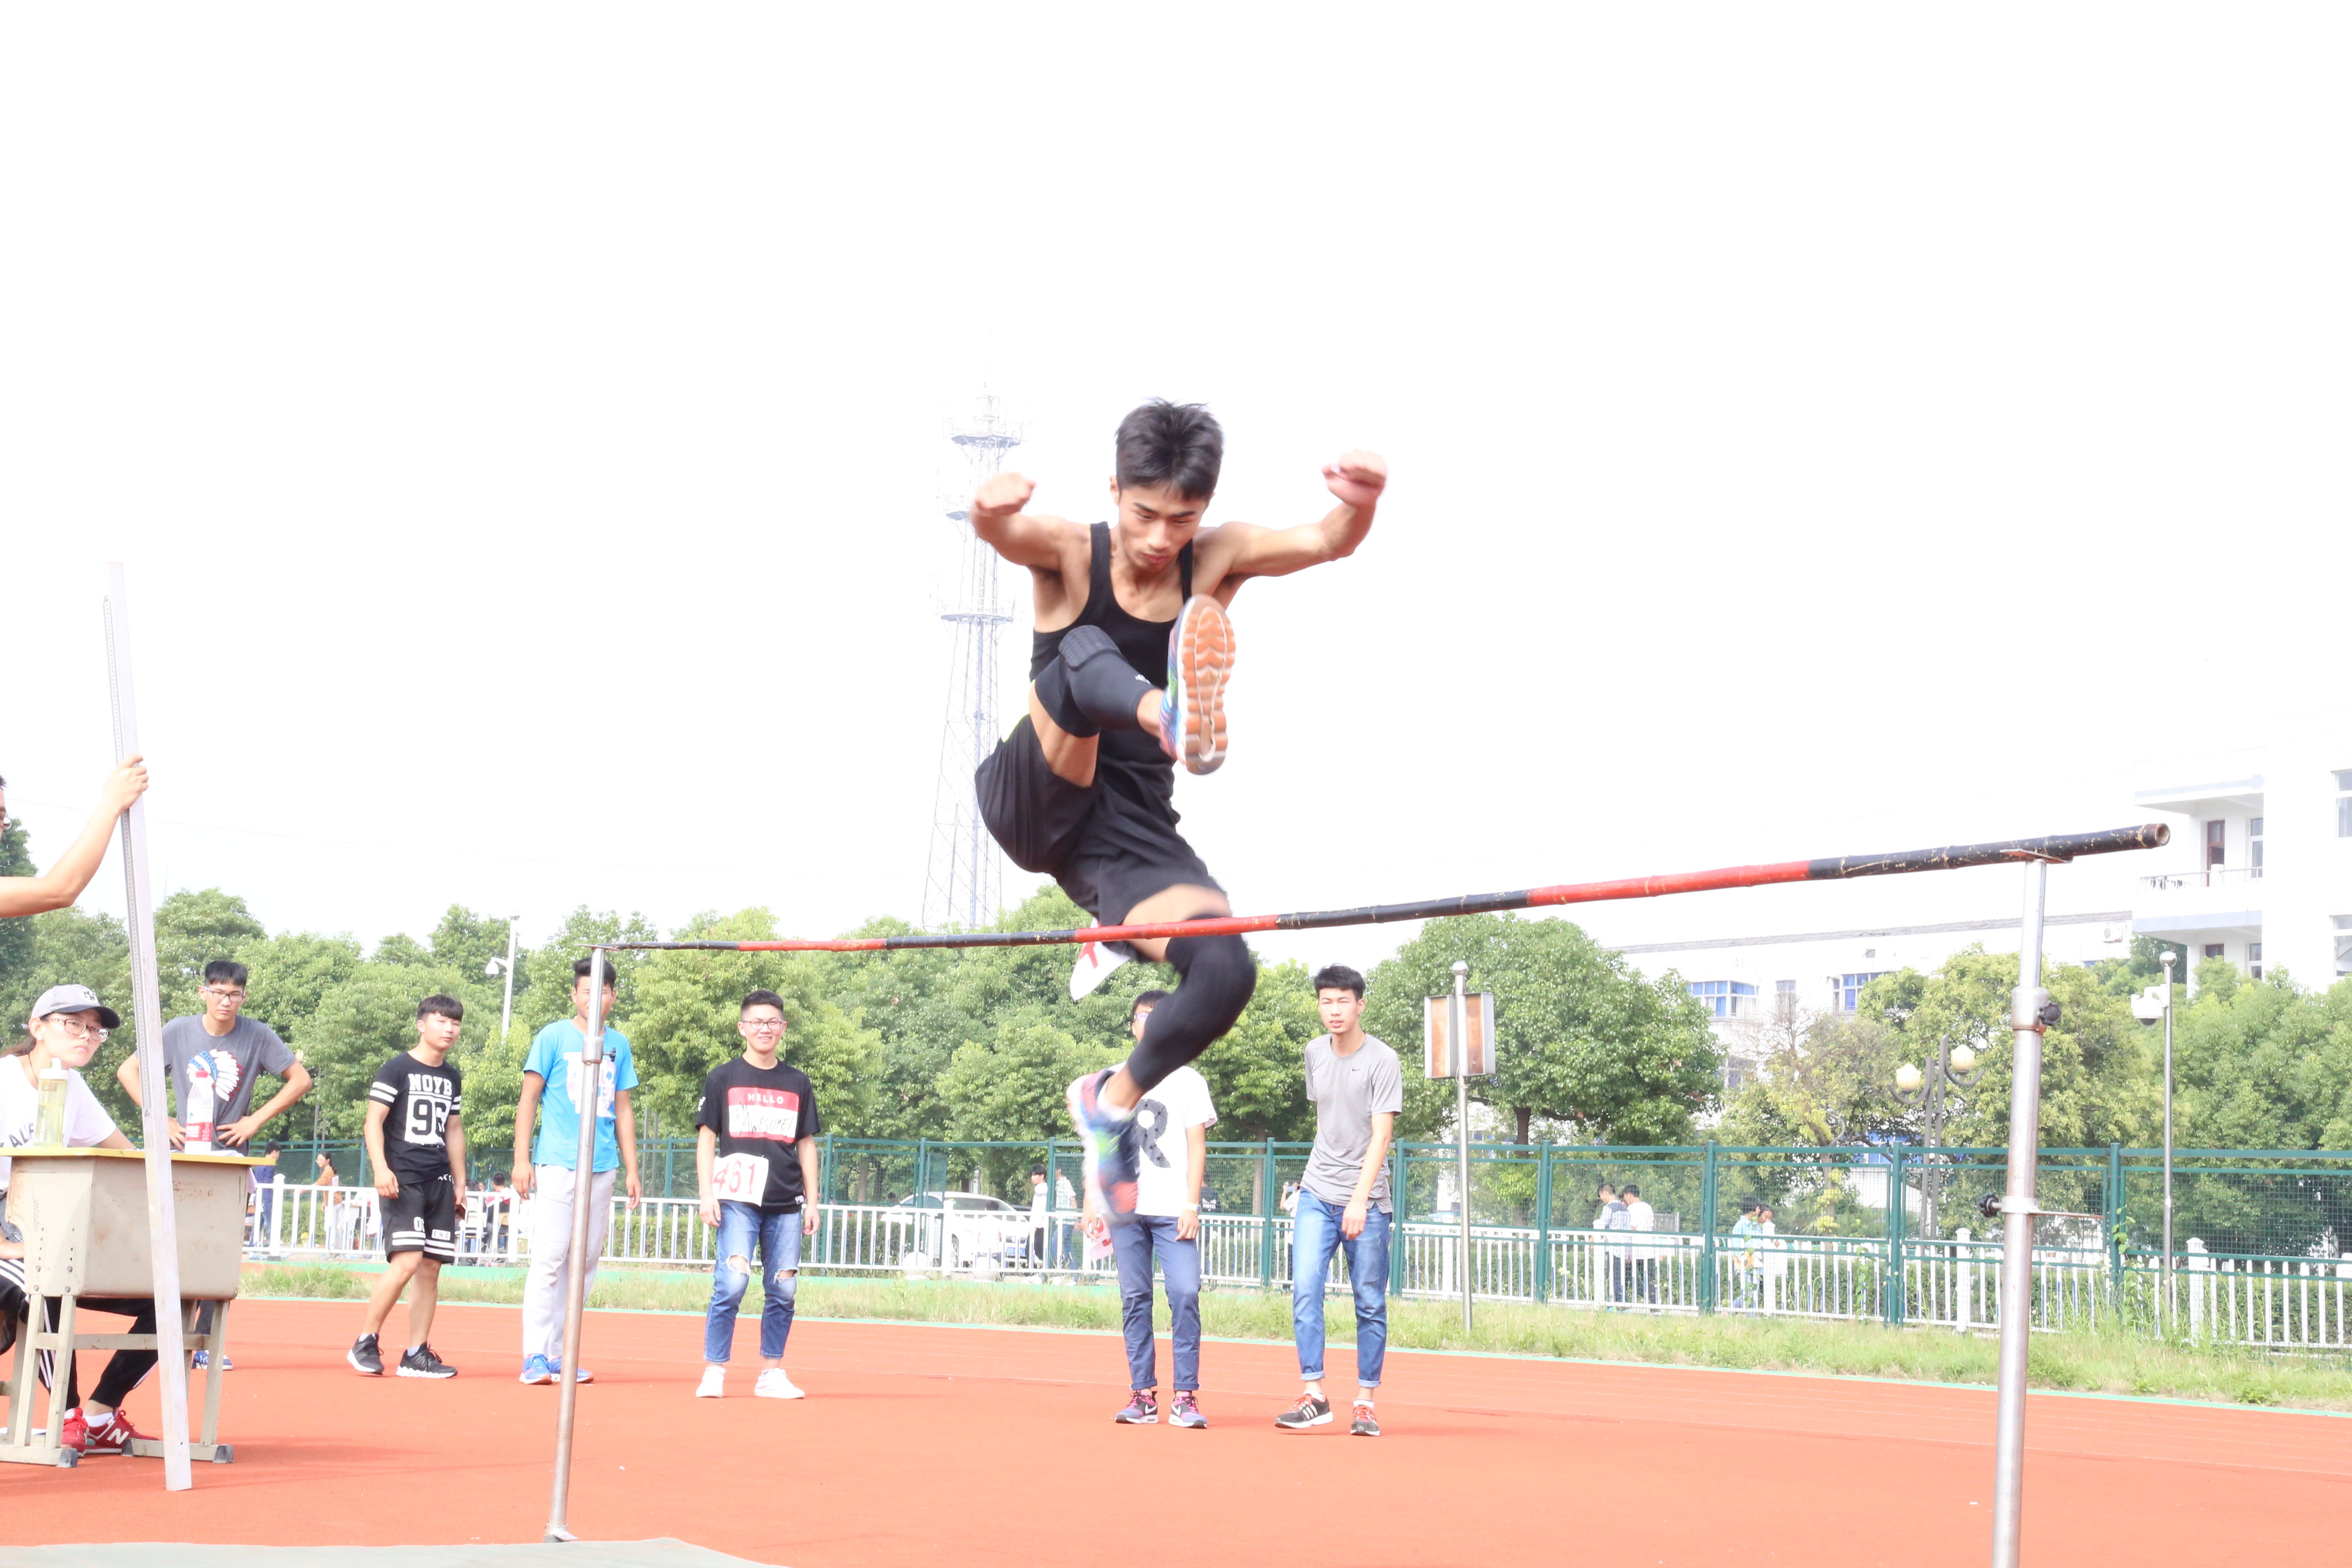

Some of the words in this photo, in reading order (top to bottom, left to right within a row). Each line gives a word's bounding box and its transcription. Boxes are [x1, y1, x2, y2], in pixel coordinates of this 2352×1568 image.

[408, 1073, 452, 1096] NOYB
[748, 1093, 784, 1104] HELLO
[0, 1123, 34, 1148] ALIF
[713, 1160, 755, 1195] 461
[107, 1427, 129, 1445] N
